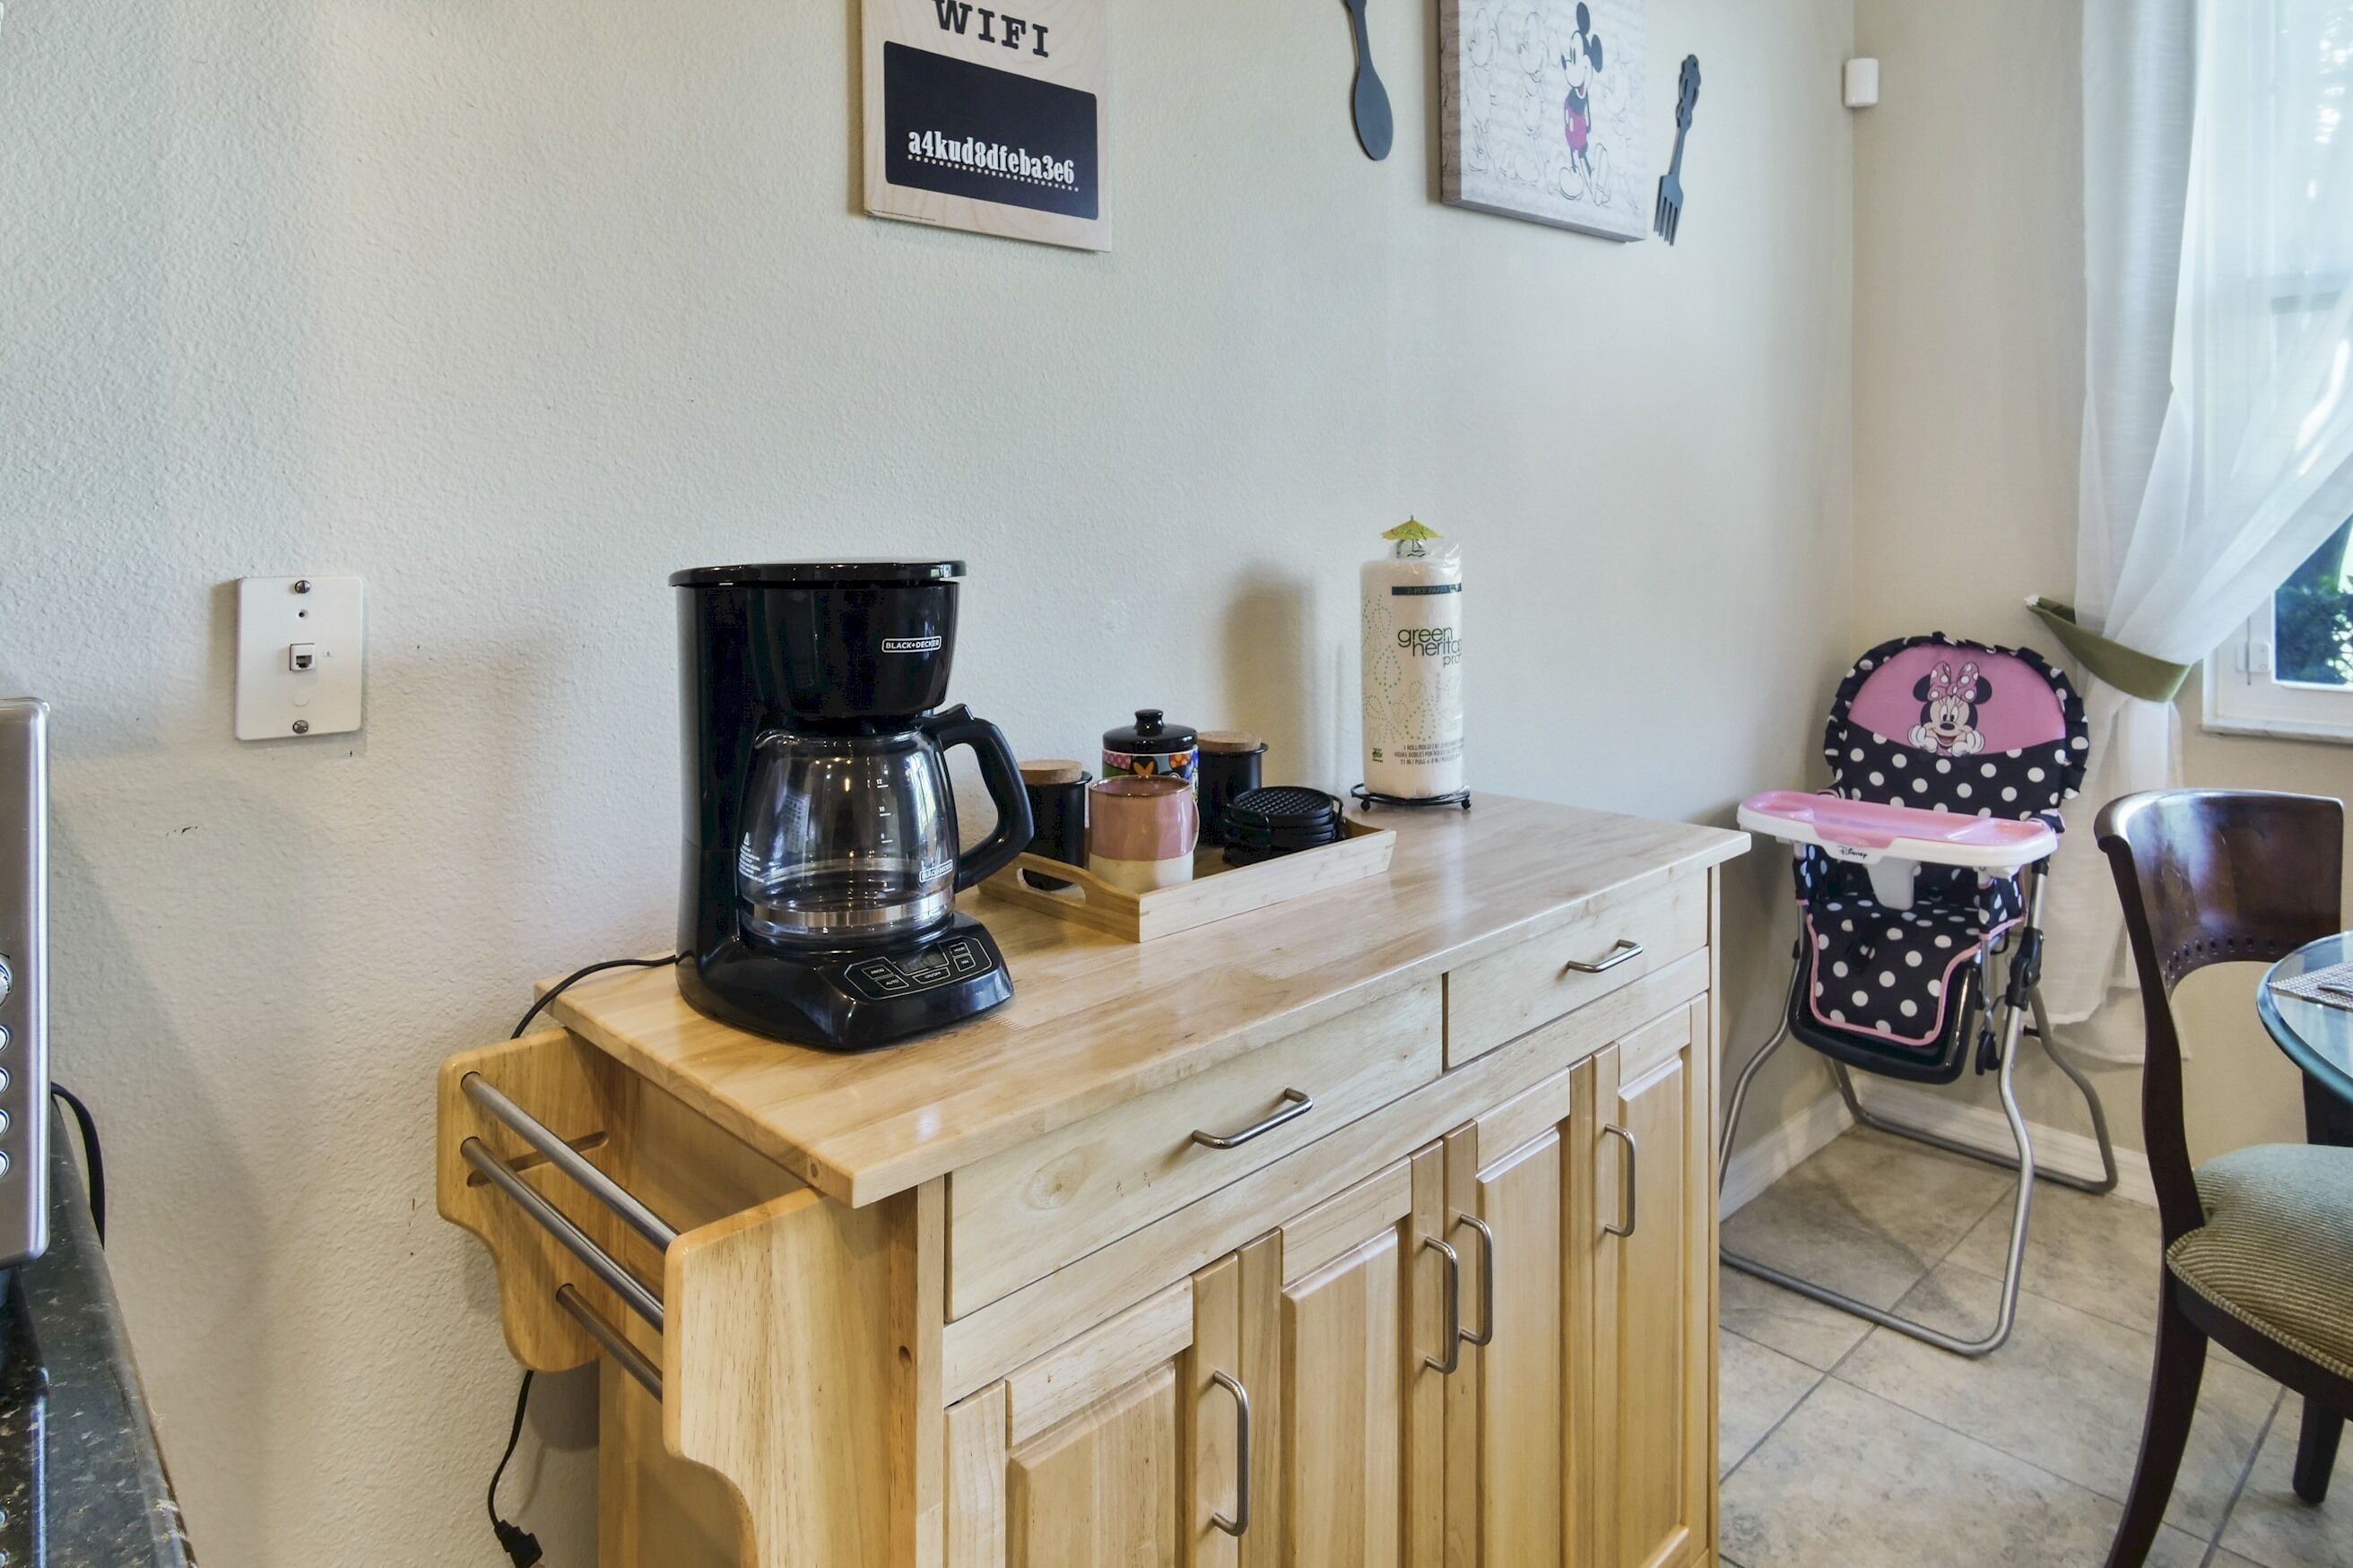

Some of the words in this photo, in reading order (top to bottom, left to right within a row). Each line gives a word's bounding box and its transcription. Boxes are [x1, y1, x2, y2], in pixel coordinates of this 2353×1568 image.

[933, 0, 1048, 57] WIFI
[907, 130, 1075, 184] a4kud8dfeba3e6
[1397, 627, 1453, 648] green
